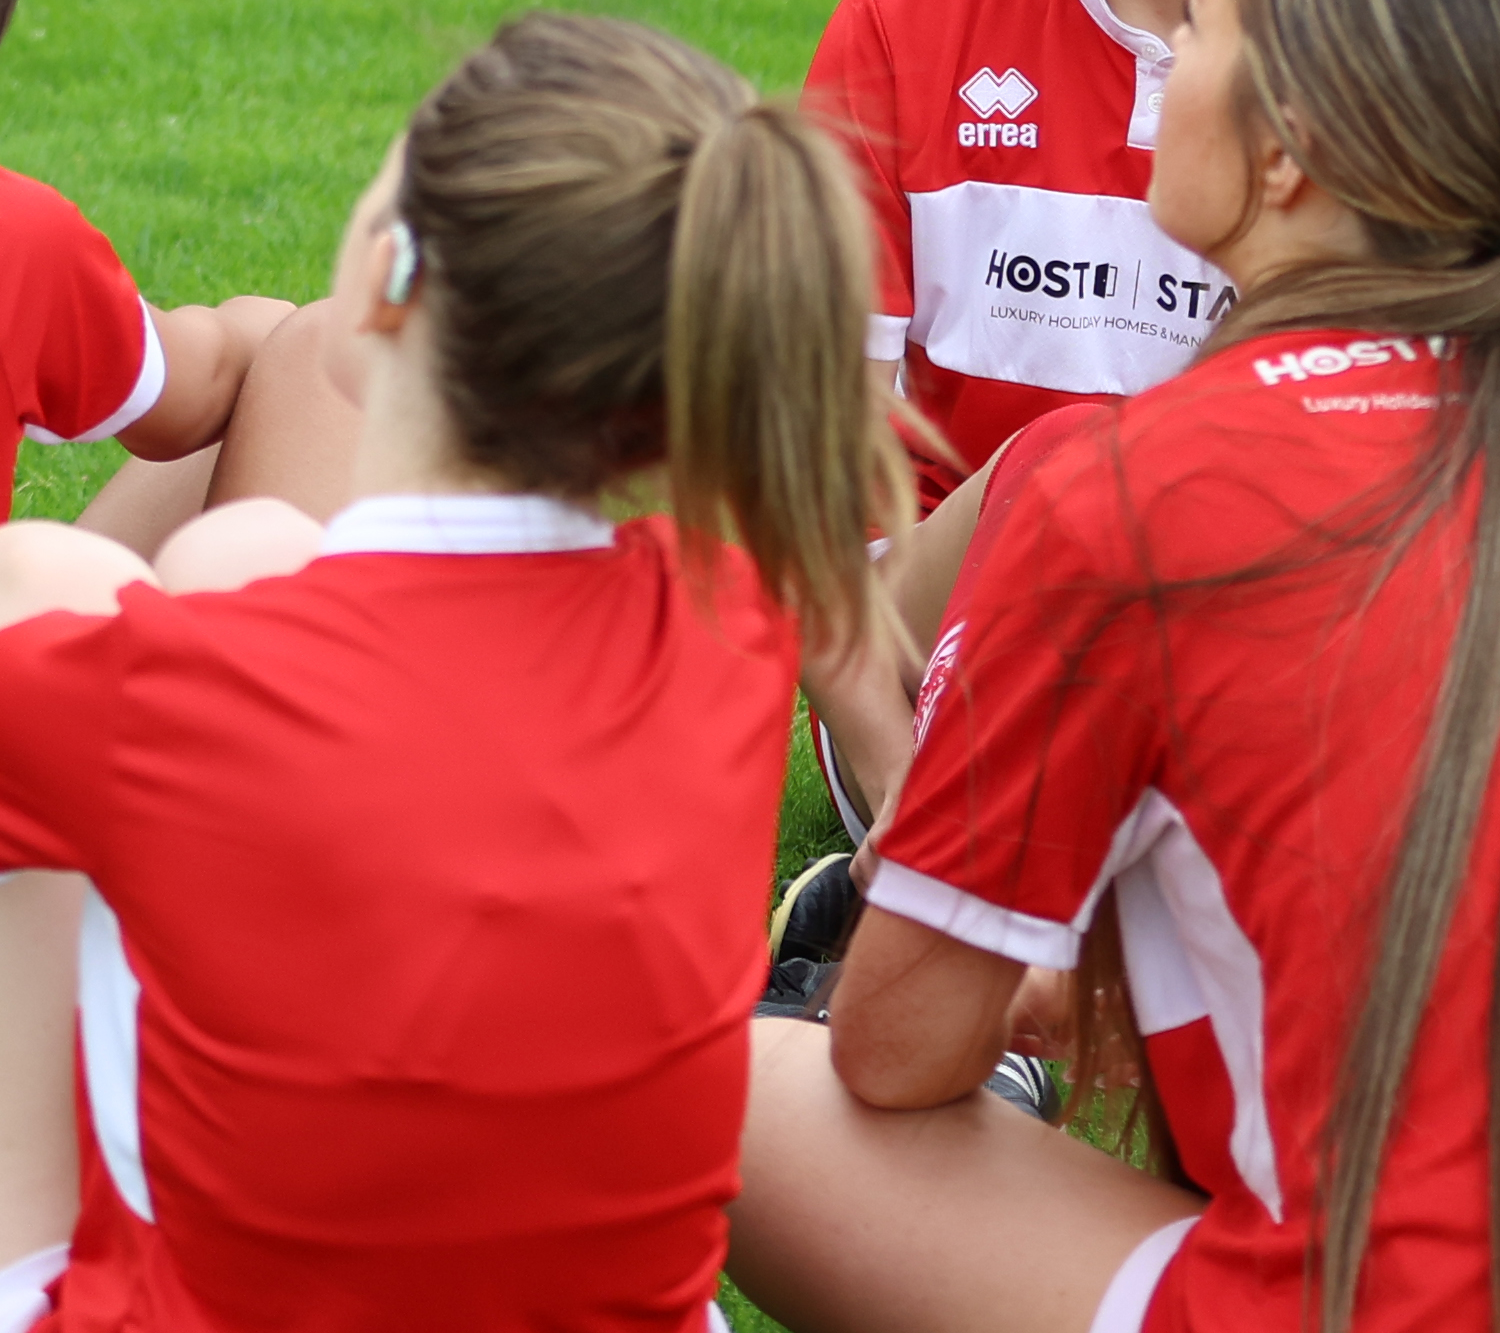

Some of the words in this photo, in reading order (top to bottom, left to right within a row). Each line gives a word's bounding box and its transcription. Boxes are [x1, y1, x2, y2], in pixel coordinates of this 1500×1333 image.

[1156, 273, 1240, 321] STA
[990, 305, 1045, 324] LUXURY
[1048, 315, 1102, 330] HOLIDAY
[1104, 317, 1158, 336] HOMES
[1160, 328, 1168, 339] &
[1302, 396, 1373, 414] Luxury
